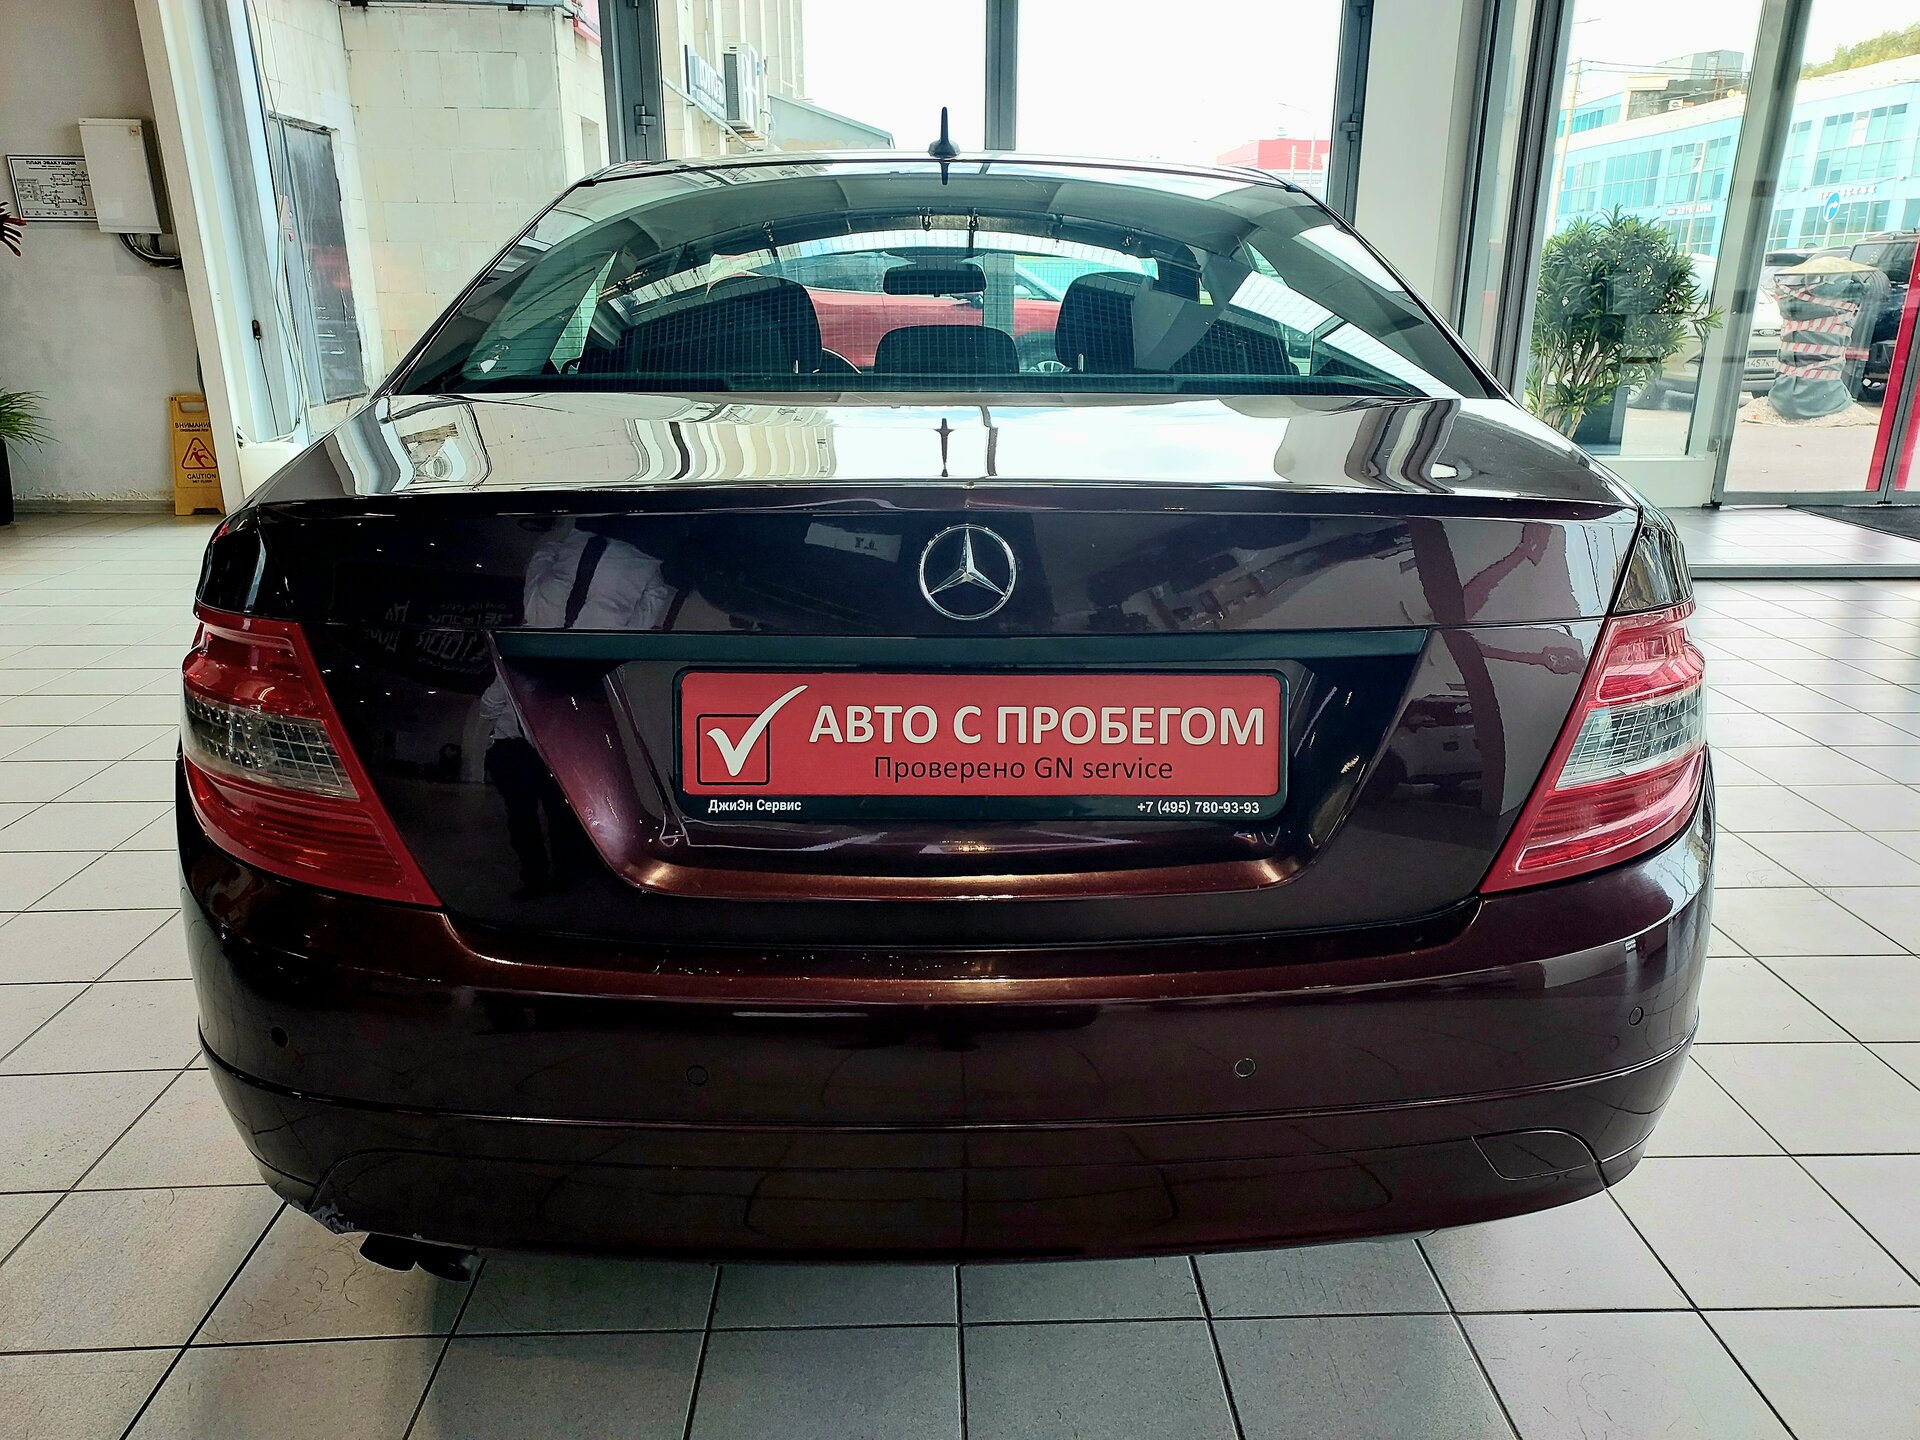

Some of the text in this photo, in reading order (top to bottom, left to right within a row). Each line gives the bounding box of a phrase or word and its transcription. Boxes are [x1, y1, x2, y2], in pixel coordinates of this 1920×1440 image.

[808, 704, 1265, 746] АВТО С ПРОБЕГОМ
[873, 757, 1174, 782] Проверено GN service
[708, 798, 802, 813] ДжиЭн Сервис
[1136, 800, 1260, 816] +7 (495) 780-93-93
